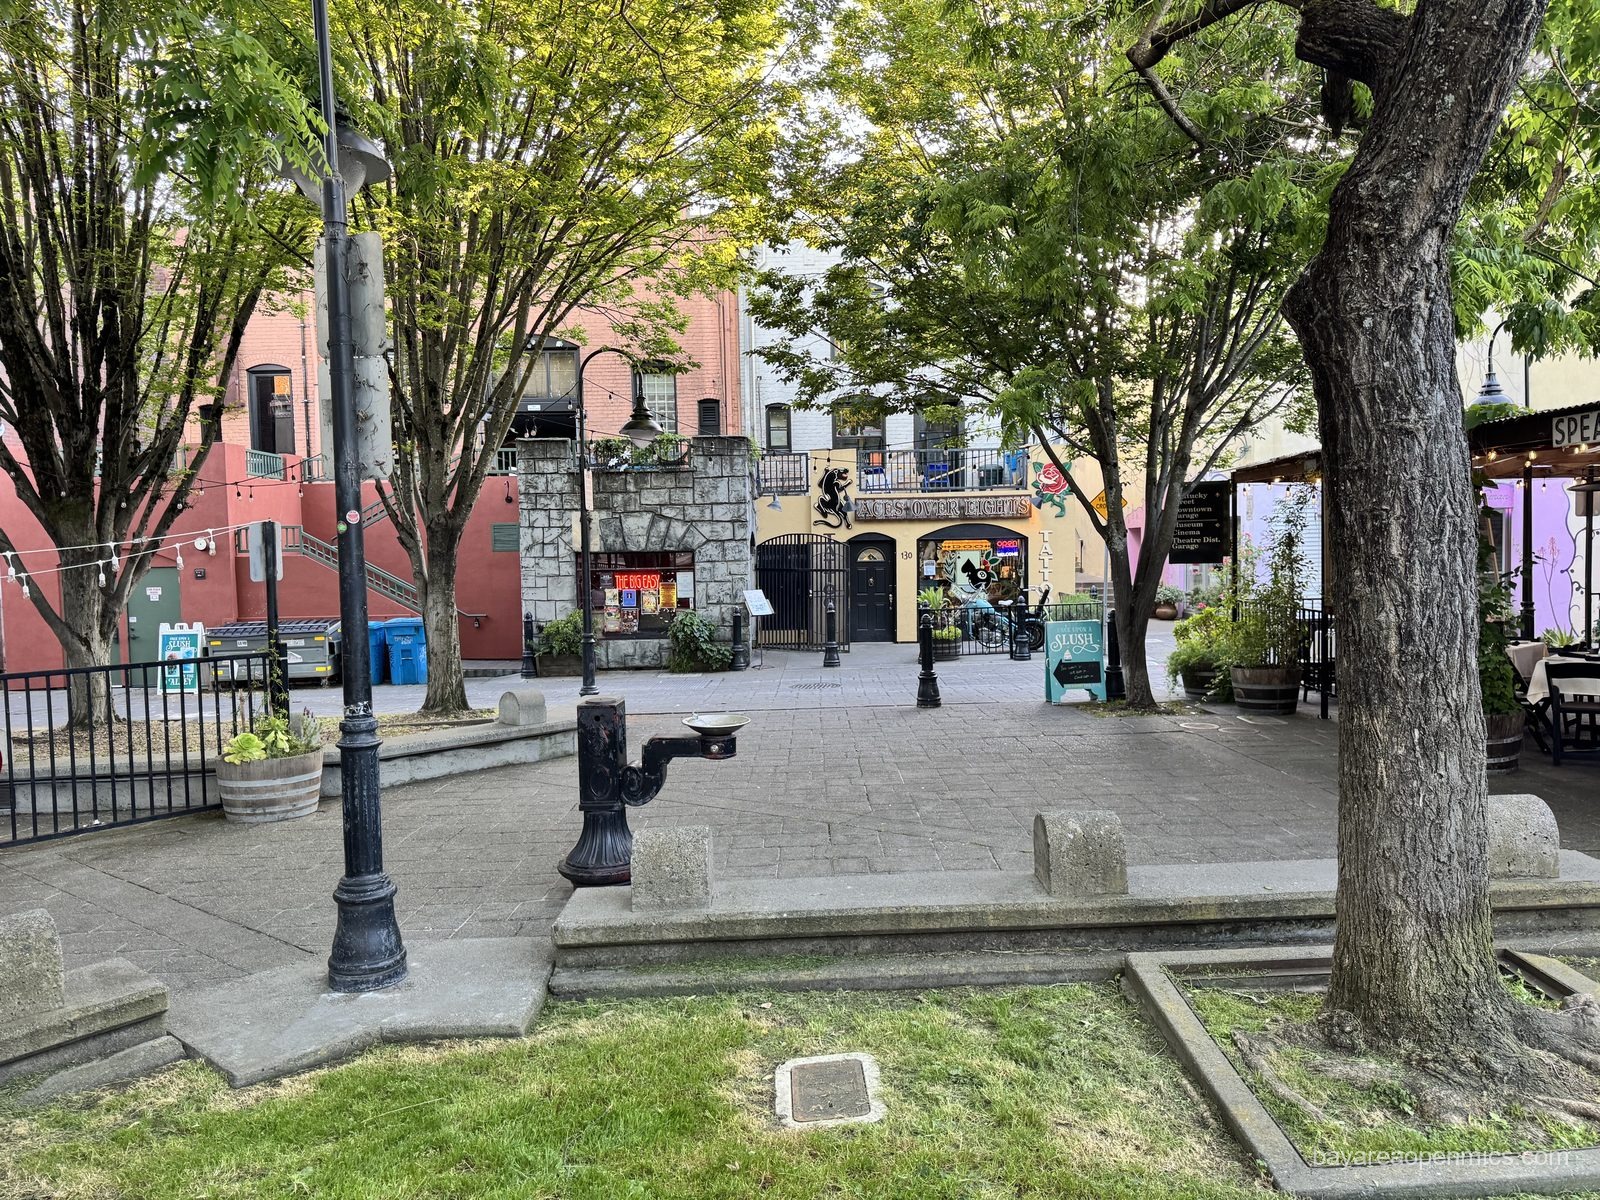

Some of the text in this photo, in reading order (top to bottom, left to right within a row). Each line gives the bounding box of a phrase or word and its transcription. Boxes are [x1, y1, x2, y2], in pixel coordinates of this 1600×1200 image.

[858, 496, 1030, 518] ACES OVER EIGHTS
[901, 551, 912, 560] 130
[615, 575, 629, 589] THE
[629, 575, 641, 589] BIG
[642, 574, 660, 589] EASY
[166, 640, 191, 651] SLUSH
[1050, 633, 1096, 652] SLUSH
[168, 677, 193, 686] ALEY
